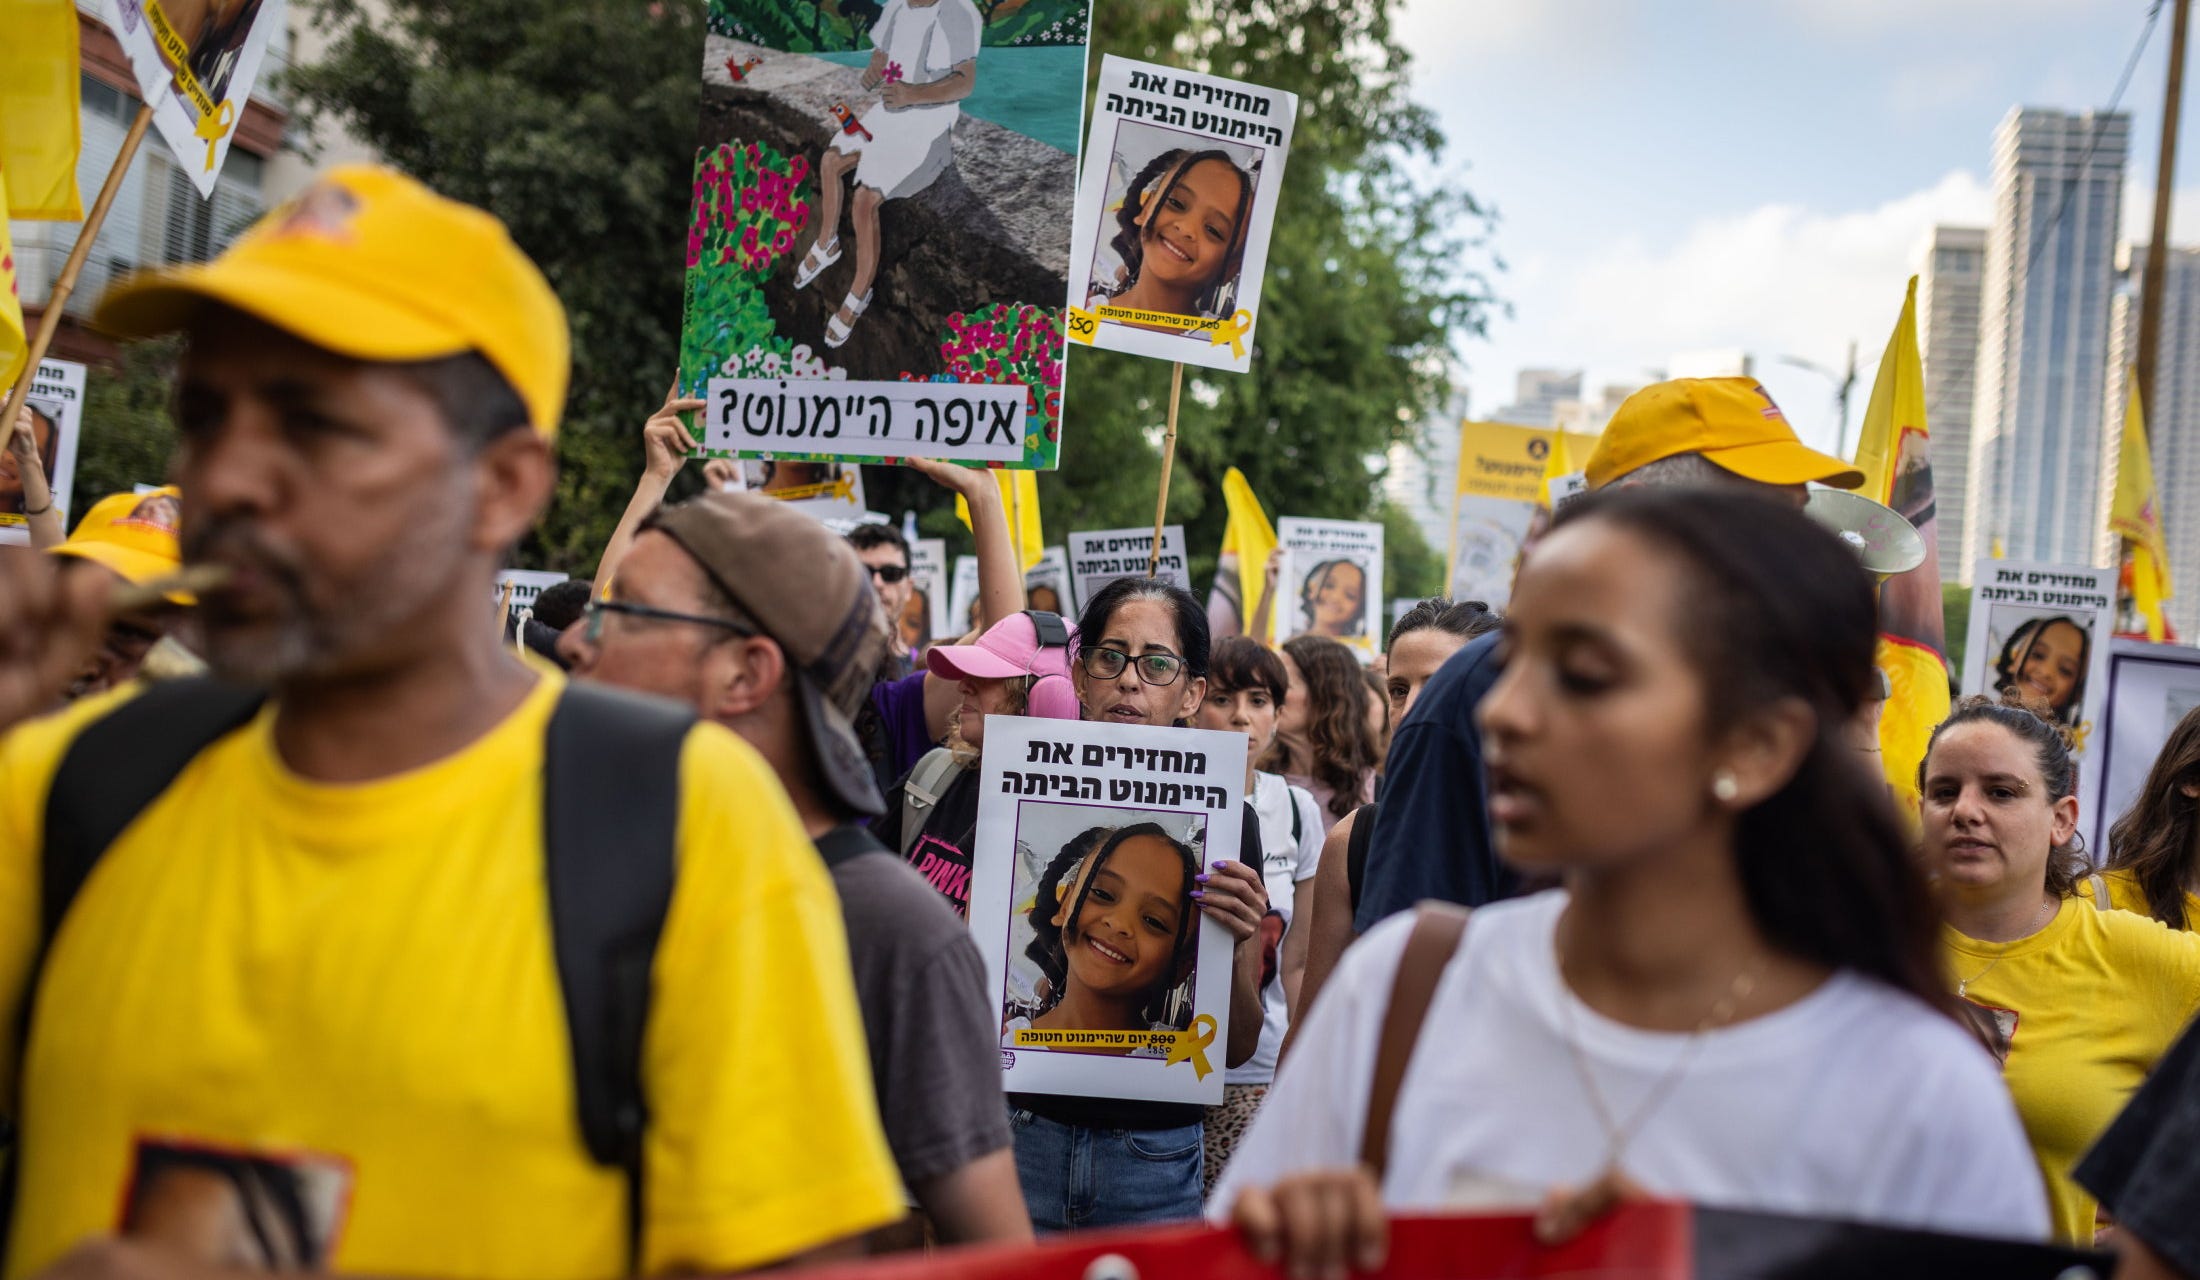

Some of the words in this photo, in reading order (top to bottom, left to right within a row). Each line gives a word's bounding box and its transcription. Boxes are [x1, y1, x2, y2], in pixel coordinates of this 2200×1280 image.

[1129, 70, 1168, 95] את
[1173, 79, 1270, 117] מחזירים
[1106, 93, 1186, 127] הביתה
[1191, 110, 1282, 147] היימנוט
[1100, 306, 1133, 320] חטופה
[1134, 311, 1181, 326] שהיימנוט
[1183, 318, 1198, 327] יום
[914, 397, 1017, 447] איפה
[1084, 539, 1105, 554] את
[1077, 558, 1120, 574] הביתה
[1123, 555, 1182, 572] היינוט
[1996, 569, 2024, 584] את
[2028, 571, 2097, 590] מחזירים
[1981, 586, 2038, 602] הביתה
[2042, 590, 2108, 608] היימנוט
[1026, 740, 1074, 765] את
[1081, 743, 1207, 776] מחזירים
[1001, 770, 1102, 800] הביתה
[1108, 778, 1228, 810] היימנוט
[1020, 1031, 1063, 1043] חטופה
[1066, 1032, 1125, 1044] שהיימנוט
[1128, 1033, 1148, 1045] יום
[1150, 1033, 1176, 1044] 800
